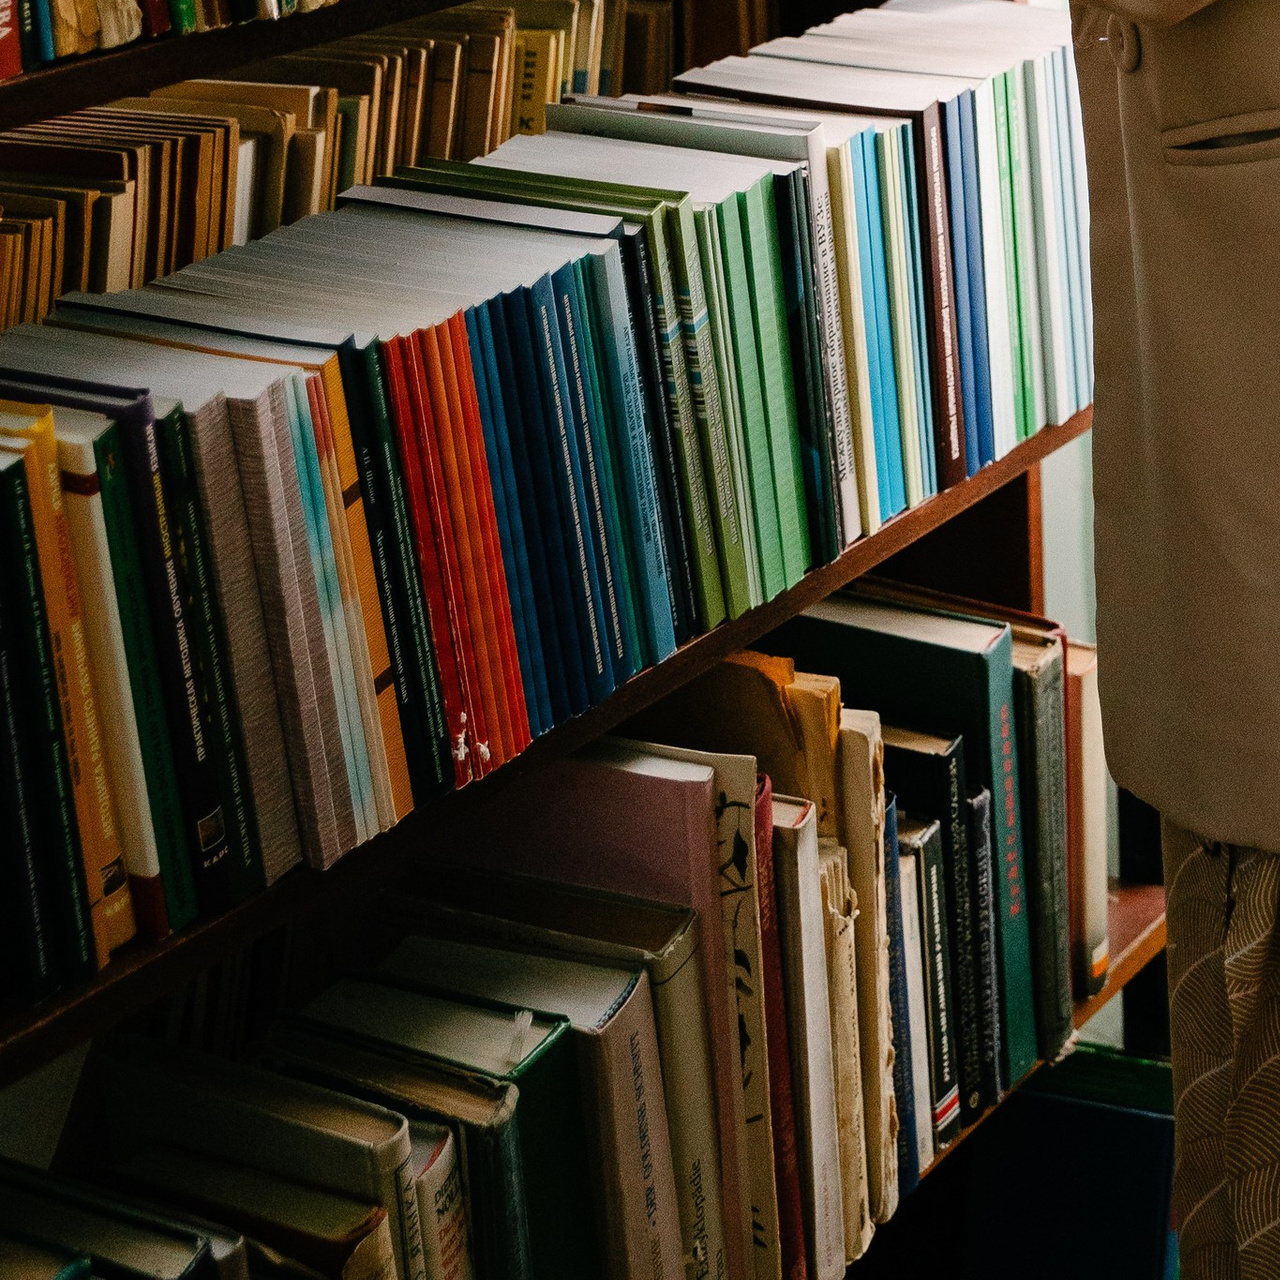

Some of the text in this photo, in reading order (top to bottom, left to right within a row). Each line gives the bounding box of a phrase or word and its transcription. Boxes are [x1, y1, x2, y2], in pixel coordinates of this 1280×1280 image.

[814, 195, 826, 245] ВУЗе:
[823, 191, 834, 250] практики
[820, 263, 837, 358] образование
[562, 294, 574, 336] АКТУАЛЬНЫЕ
[568, 335, 580, 373] ПРОБЛЕМЫ
[575, 377, 588, 423] СОВРЕМЕННЫЕ
[621, 326, 636, 381] АКТУАЛЬНЫЕ
[630, 382, 643, 428] ПРОБЛЕМЫ
[829, 361, 849, 480] Межкультурное
[624, 399, 636, 432] ЗАДАЧИ
[630, 442, 646, 500] ПЕРСПЕКТИВЫ
[639, 501, 652, 544] РАЗВИТИЯ
[143, 422, 206, 761] ПРАКТИЧЕСКАЯ МЕТОДИКА ОБУЧЕНИЯ ИНОСТРАННЫМ ЯЗЫКАМ
[374, 528, 390, 579] Методика
[381, 580, 397, 623] обучения
[388, 623, 404, 674] немецкому
[186, 500, 207, 588] ИНОСТРАННЫЙ
[201, 590, 213, 621] ЯЗЫК
[208, 634, 225, 702] НАЧАЛЬНОЙ
[227, 751, 240, 795] ТЕОРИЯ
[235, 807, 252, 867] ПРАКТИКА
[396, 675, 408, 703] языку
